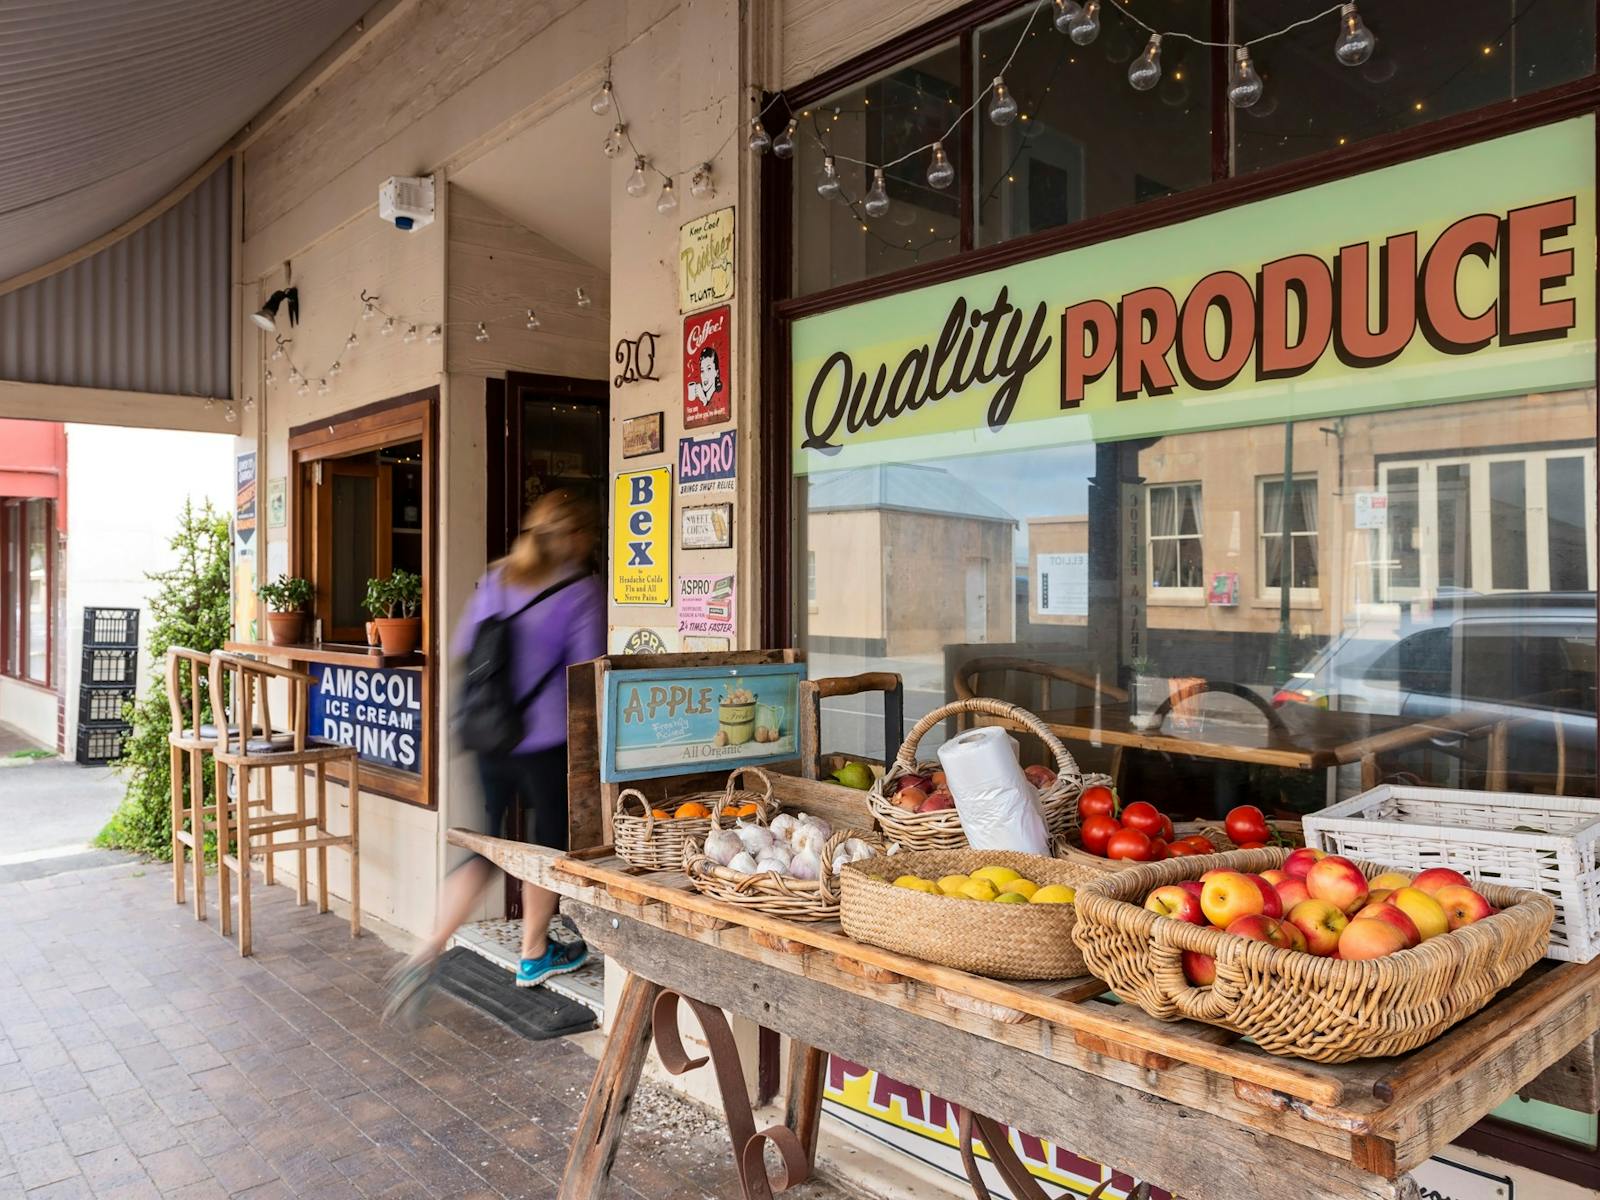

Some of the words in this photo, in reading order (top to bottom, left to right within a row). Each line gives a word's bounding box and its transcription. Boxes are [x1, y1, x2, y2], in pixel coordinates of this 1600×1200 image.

[687, 316, 724, 355] Coffee!
[801, 286, 1052, 456] Quality
[1061, 196, 1577, 410] PRODUCE
[614, 331, 660, 388] 20
[680, 484, 698, 494] BRINGS
[699, 482, 716, 492] SWIFT
[628, 476, 654, 566] Bex
[619, 576, 645, 584] Headache
[647, 575, 663, 583] Colds
[625, 585, 634, 593] Flu
[636, 585, 646, 593] and
[648, 584, 656, 592] All
[643, 593, 657, 601] Pains
[689, 622, 707, 632] TIMES
[708, 622, 732, 632] FASTER
[320, 666, 421, 710] AMSCOL
[624, 685, 713, 724] APPLE
[326, 699, 349, 717] ICE
[356, 704, 413, 730] CREAM
[323, 718, 415, 766] DRINKS
[682, 745, 699, 759] All
[702, 744, 743, 758] Organic
